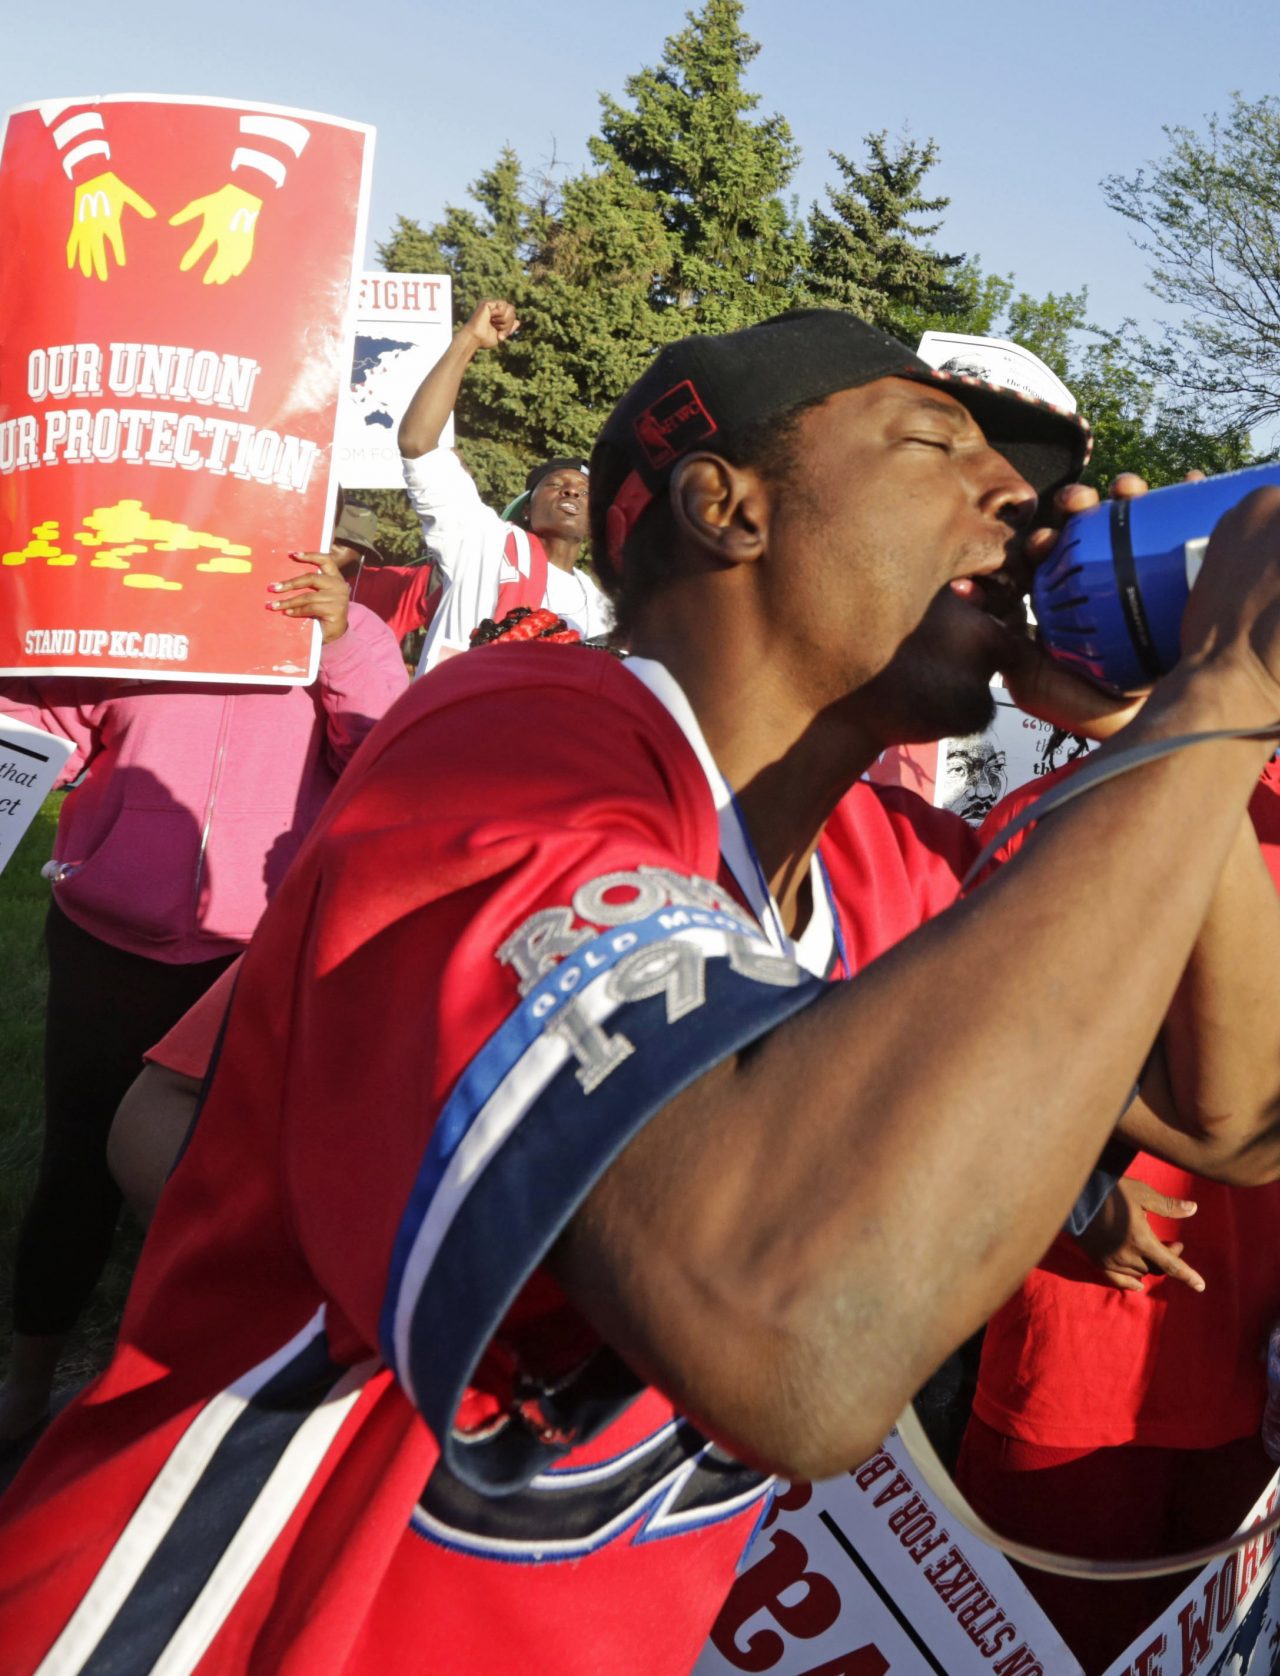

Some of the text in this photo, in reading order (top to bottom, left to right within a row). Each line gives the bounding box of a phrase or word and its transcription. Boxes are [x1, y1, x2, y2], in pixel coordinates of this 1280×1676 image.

[27, 342, 261, 413] OUR UNION
[0, 408, 322, 494] UR PROTECTION
[25, 629, 189, 661] STAND UP KC.ORG
[871, 1470, 914, 1509] A
[887, 1490, 949, 1565] FOR
[923, 1543, 1016, 1659] STRIKE
